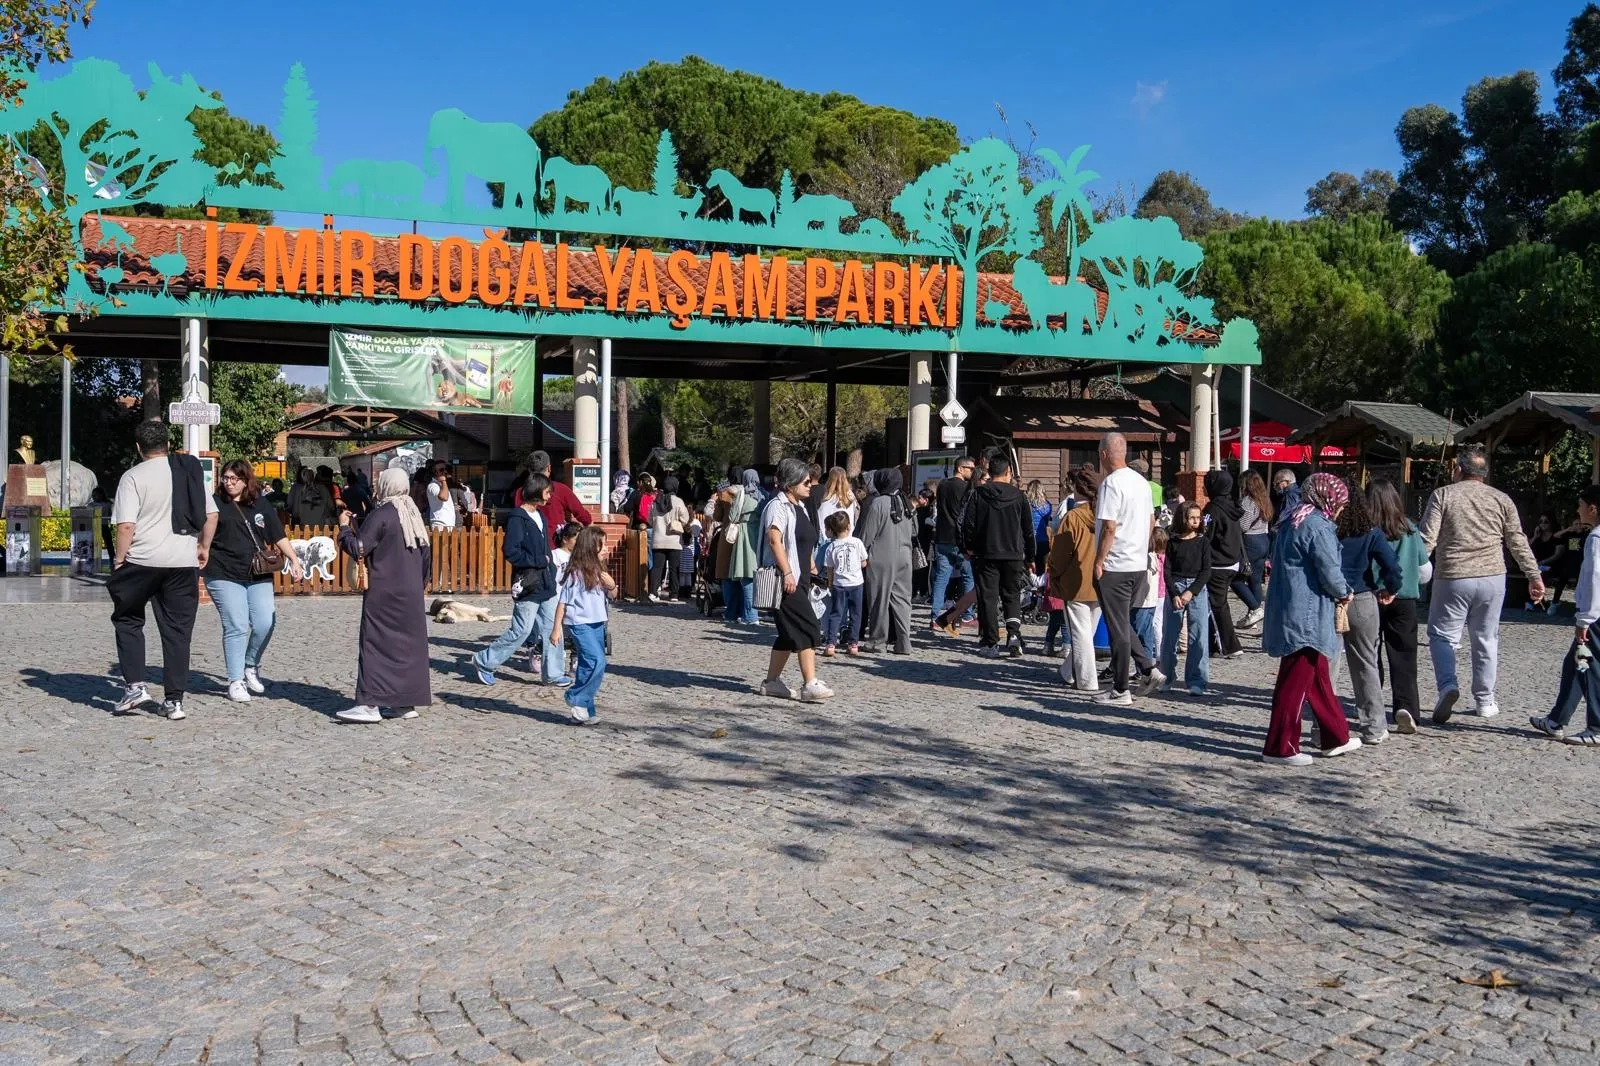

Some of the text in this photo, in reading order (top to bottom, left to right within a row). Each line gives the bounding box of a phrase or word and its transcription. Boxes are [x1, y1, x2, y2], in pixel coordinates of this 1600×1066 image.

[203, 207, 961, 330] İZMİR DOĞAL YAŞAM PARKI
